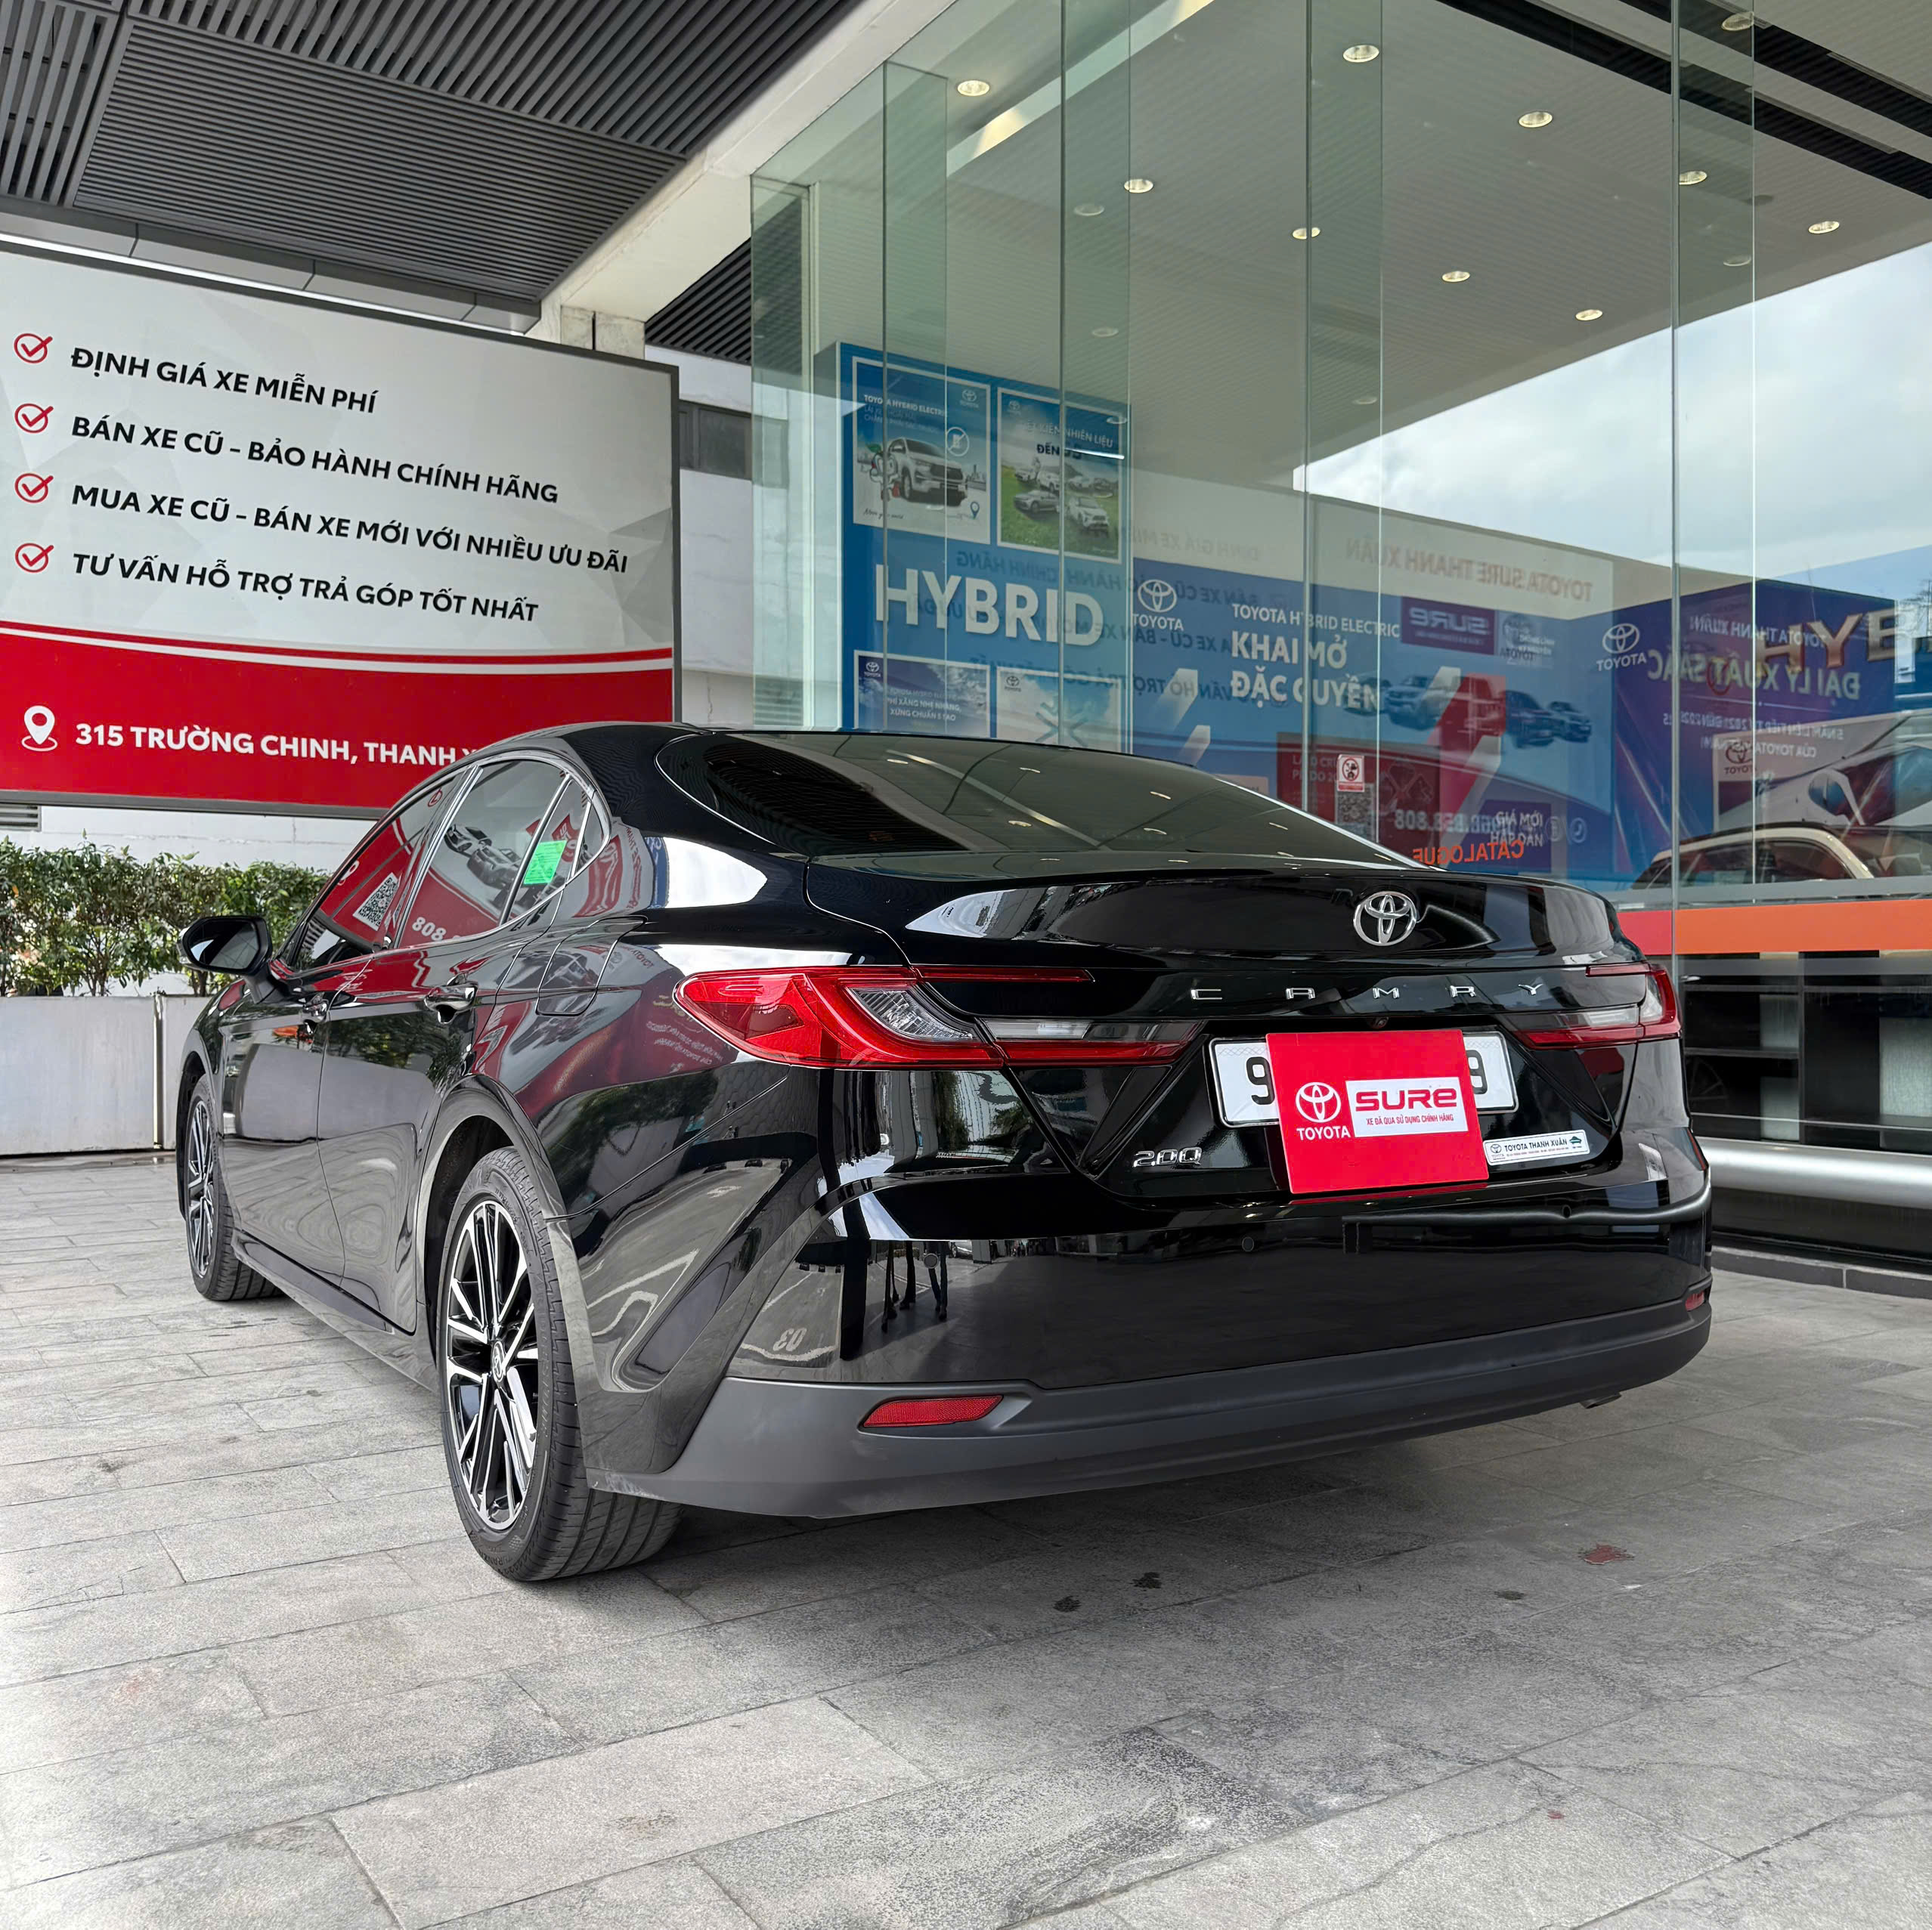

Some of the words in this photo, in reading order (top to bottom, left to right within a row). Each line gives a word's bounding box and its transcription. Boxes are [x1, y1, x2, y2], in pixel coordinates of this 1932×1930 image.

[70, 347, 150, 379] ĐỊNH
[156, 360, 208, 388] GIÁ
[213, 370, 249, 394] XE
[255, 373, 326, 406] MIỄN
[331, 389, 379, 413] PHÍ
[864, 394, 891, 407] TOYOA
[919, 405, 946, 417] ELECTRI
[72, 414, 135, 444] BÁN
[140, 425, 178, 450] XE
[184, 430, 224, 455] CŨ
[247, 438, 305, 467] BẢO
[311, 448, 392, 479] HÀNH
[397, 462, 481, 492] CHÍNH
[485, 474, 558, 503] HÃNG
[72, 484, 141, 512] MUA
[147, 494, 184, 517] XE
[190, 497, 230, 522] CŨ
[253, 505, 312, 533] BÁN
[317, 515, 351, 538] XE
[356, 519, 410, 545] MỚI
[416, 526, 460, 552] VỚI
[466, 534, 543, 561] NHIỀU
[549, 543, 583, 567] ƯU
[587, 549, 628, 574] ĐÃI
[73, 553, 115, 576] TƯ
[119, 554, 180, 583] VẤN
[186, 558, 230, 588] HỖ
[237, 571, 293, 602] TRỢ
[299, 575, 348, 602] TRẢ
[356, 582, 413, 608] GÓP
[420, 586, 467, 614] TỐT
[471, 596, 539, 622] NHẤT
[875, 564, 1104, 647] HYBRID
[1133, 613, 1184, 632] TOYOTA
[1232, 604, 1286, 623] TOYOTA
[1290, 611, 1338, 631] HBRID
[1340, 617, 1401, 639] ELECTRIC
[1231, 630, 1299, 664] KHAI
[1307, 634, 1348, 670] MỞ
[1596, 652, 1648, 672] TOYOTA
[1230, 665, 1288, 709] ĐẶC
[75, 723, 124, 747] 315
[129, 723, 255, 754] TRƯỜNG
[260, 735, 358, 765] CHINH,
[363, 741, 456, 766] THANH
[1190, 982, 1544, 1001] CAMRY
[1246, 1056, 1276, 1106] 9
[1296, 1125, 1351, 1141] TOYOTA
[1366, 1118, 1374, 1126] XE
[1374, 1116, 1384, 1126] ĐÃ
[1383, 1117, 1395, 1125] QUA
[1421, 1114, 1438, 1123] CHÍNH
[1438, 1113, 1454, 1122] HÃNG
[1504, 1143, 1528, 1152] TOYOTA
[1528, 1140, 1550, 1149] THANH
[1550, 1137, 1568, 1147] XUÂN
